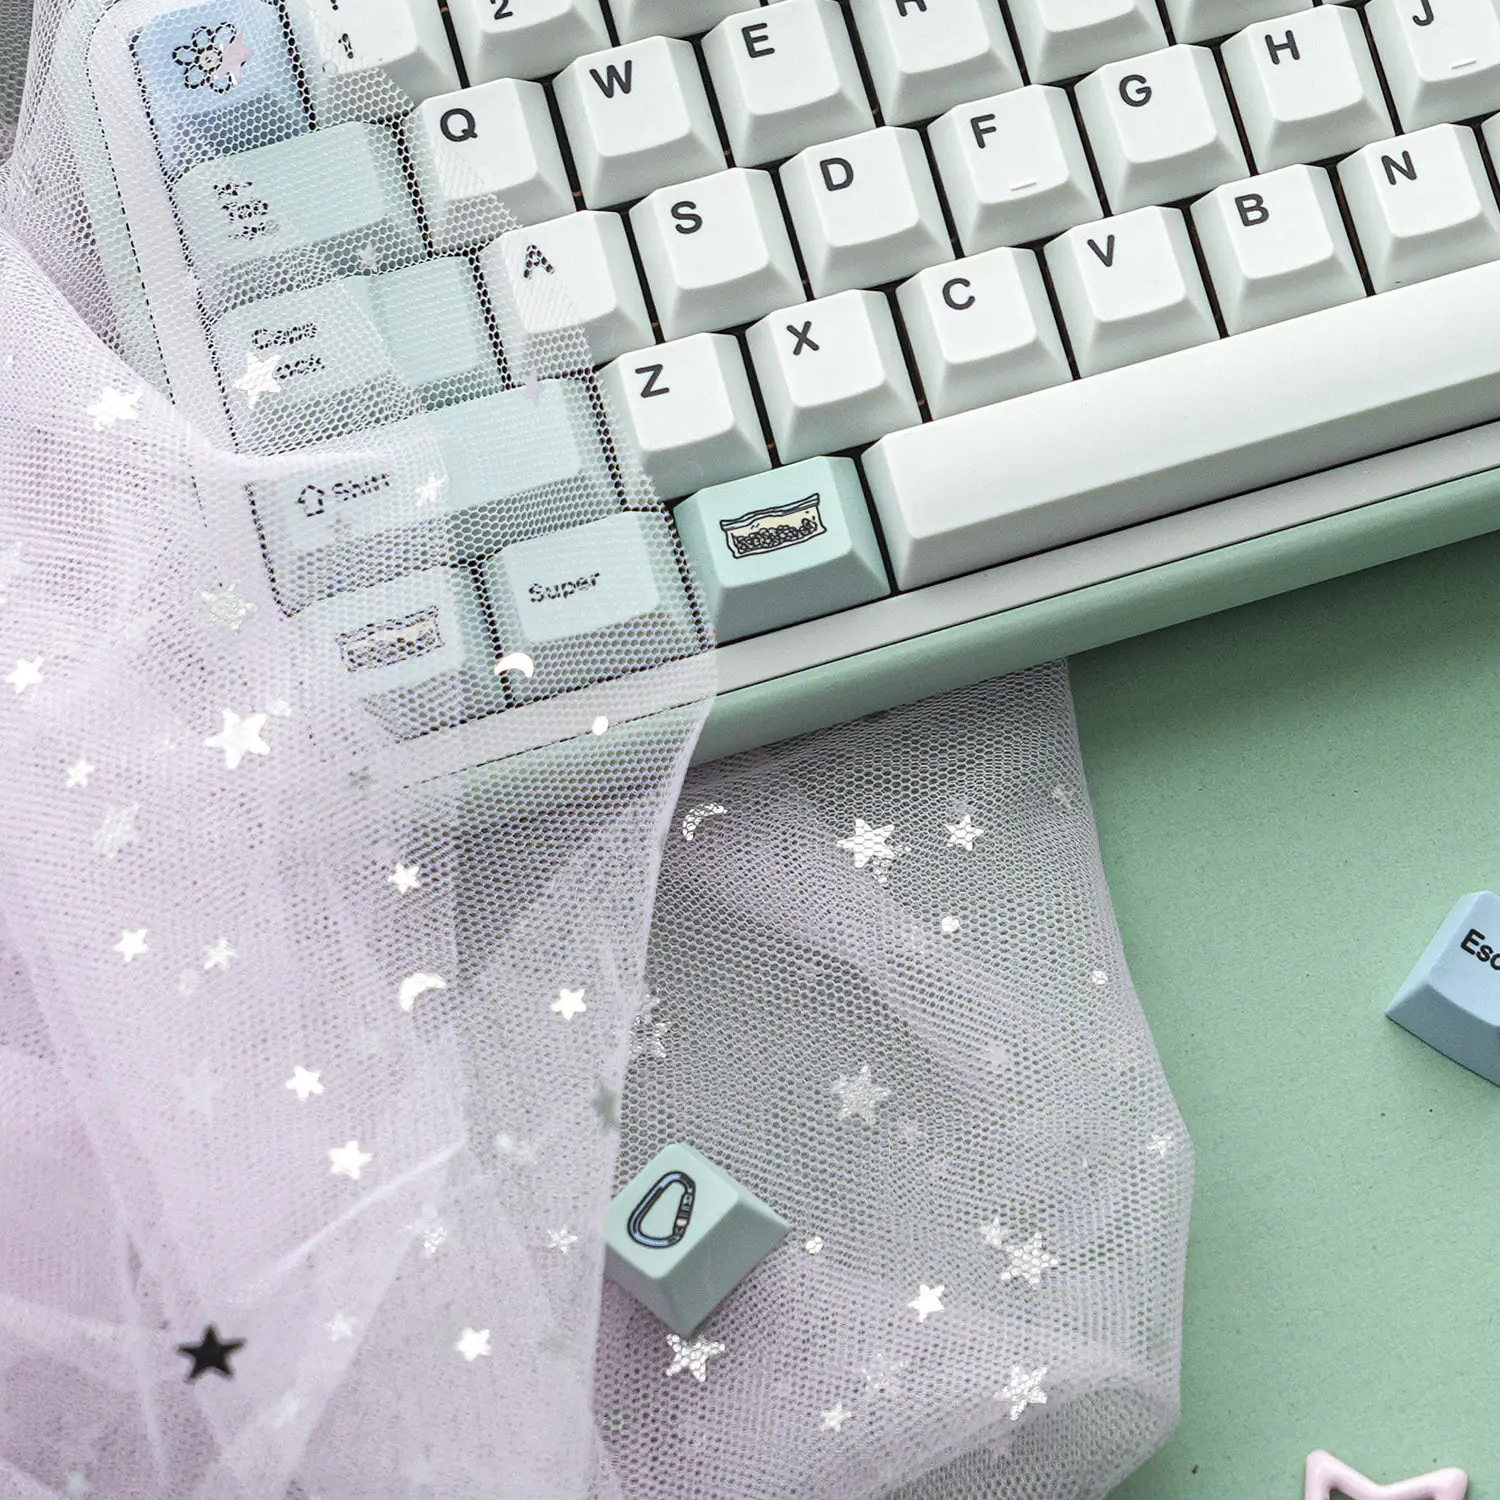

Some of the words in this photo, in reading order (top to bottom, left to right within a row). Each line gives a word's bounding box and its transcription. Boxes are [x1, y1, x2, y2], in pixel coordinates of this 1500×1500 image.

[741, 22, 776, 59] E
[1264, 29, 1301, 65] H
[589, 59, 633, 99] W
[1118, 74, 1153, 108] G
[439, 107, 478, 143] Q
[970, 113, 997, 149] F
[819, 157, 854, 192] D
[1381, 150, 1418, 186] N
[670, 200, 703, 235] S
[1234, 193, 1270, 227] B
[523, 244, 554, 279] A
[1086, 234, 1115, 268] V
[942, 277, 976, 311] C
[786, 320, 820, 356] X
[272, 354, 327, 381] ock
[634, 363, 670, 399] Z
[528, 572, 600, 603] Super
